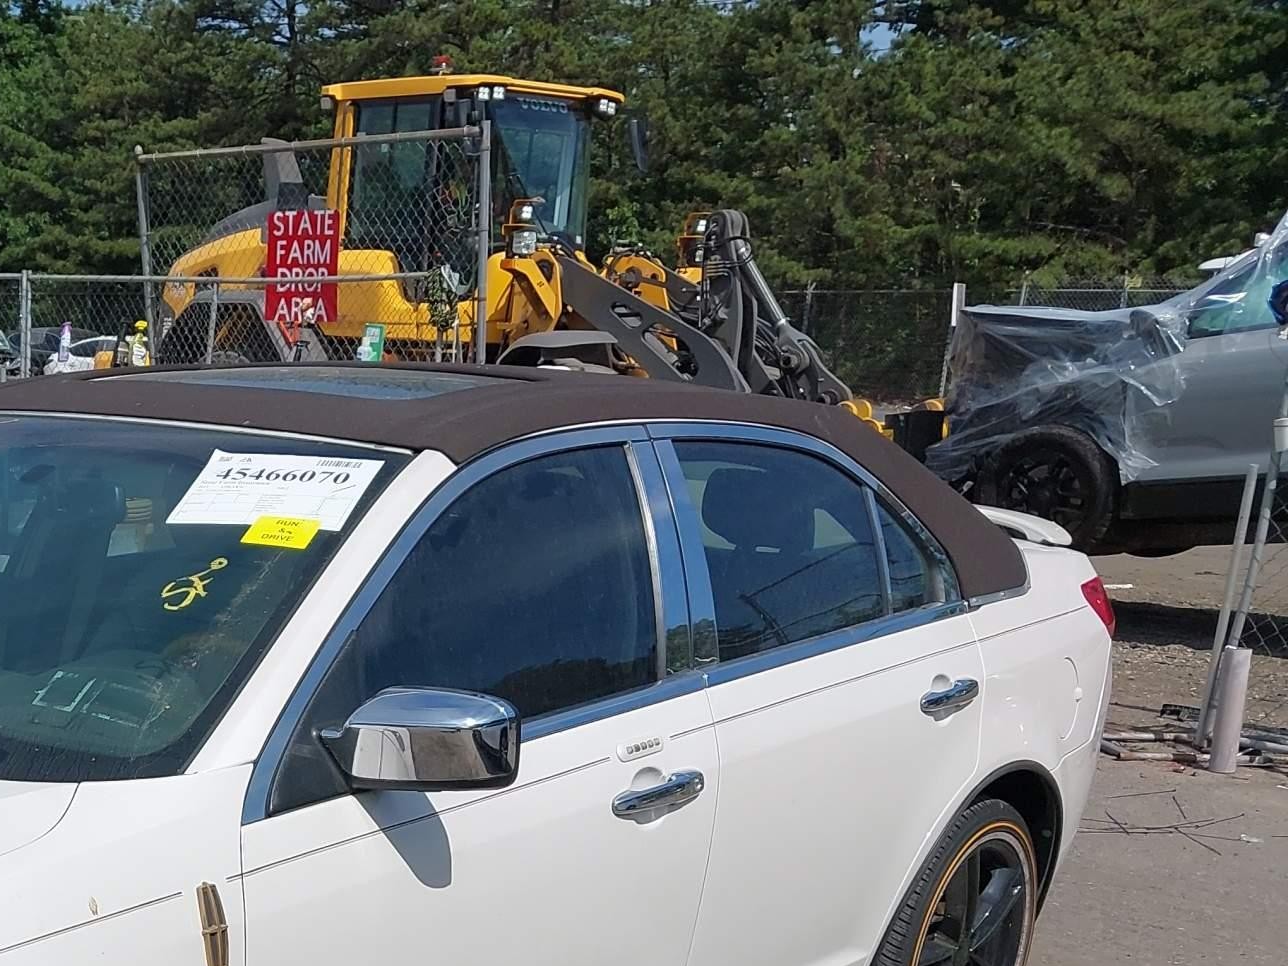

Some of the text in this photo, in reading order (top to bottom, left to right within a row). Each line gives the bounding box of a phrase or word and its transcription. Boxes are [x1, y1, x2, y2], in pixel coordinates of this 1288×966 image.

[273, 209, 334, 237] STATE
[276, 239, 331, 265] FARM
[276, 267, 329, 293] DROP
[273, 297, 328, 323] ARA
[216, 467, 351, 485] 45466070
[276, 519, 300, 527] RUN
[261, 533, 294, 542] DRIVE
